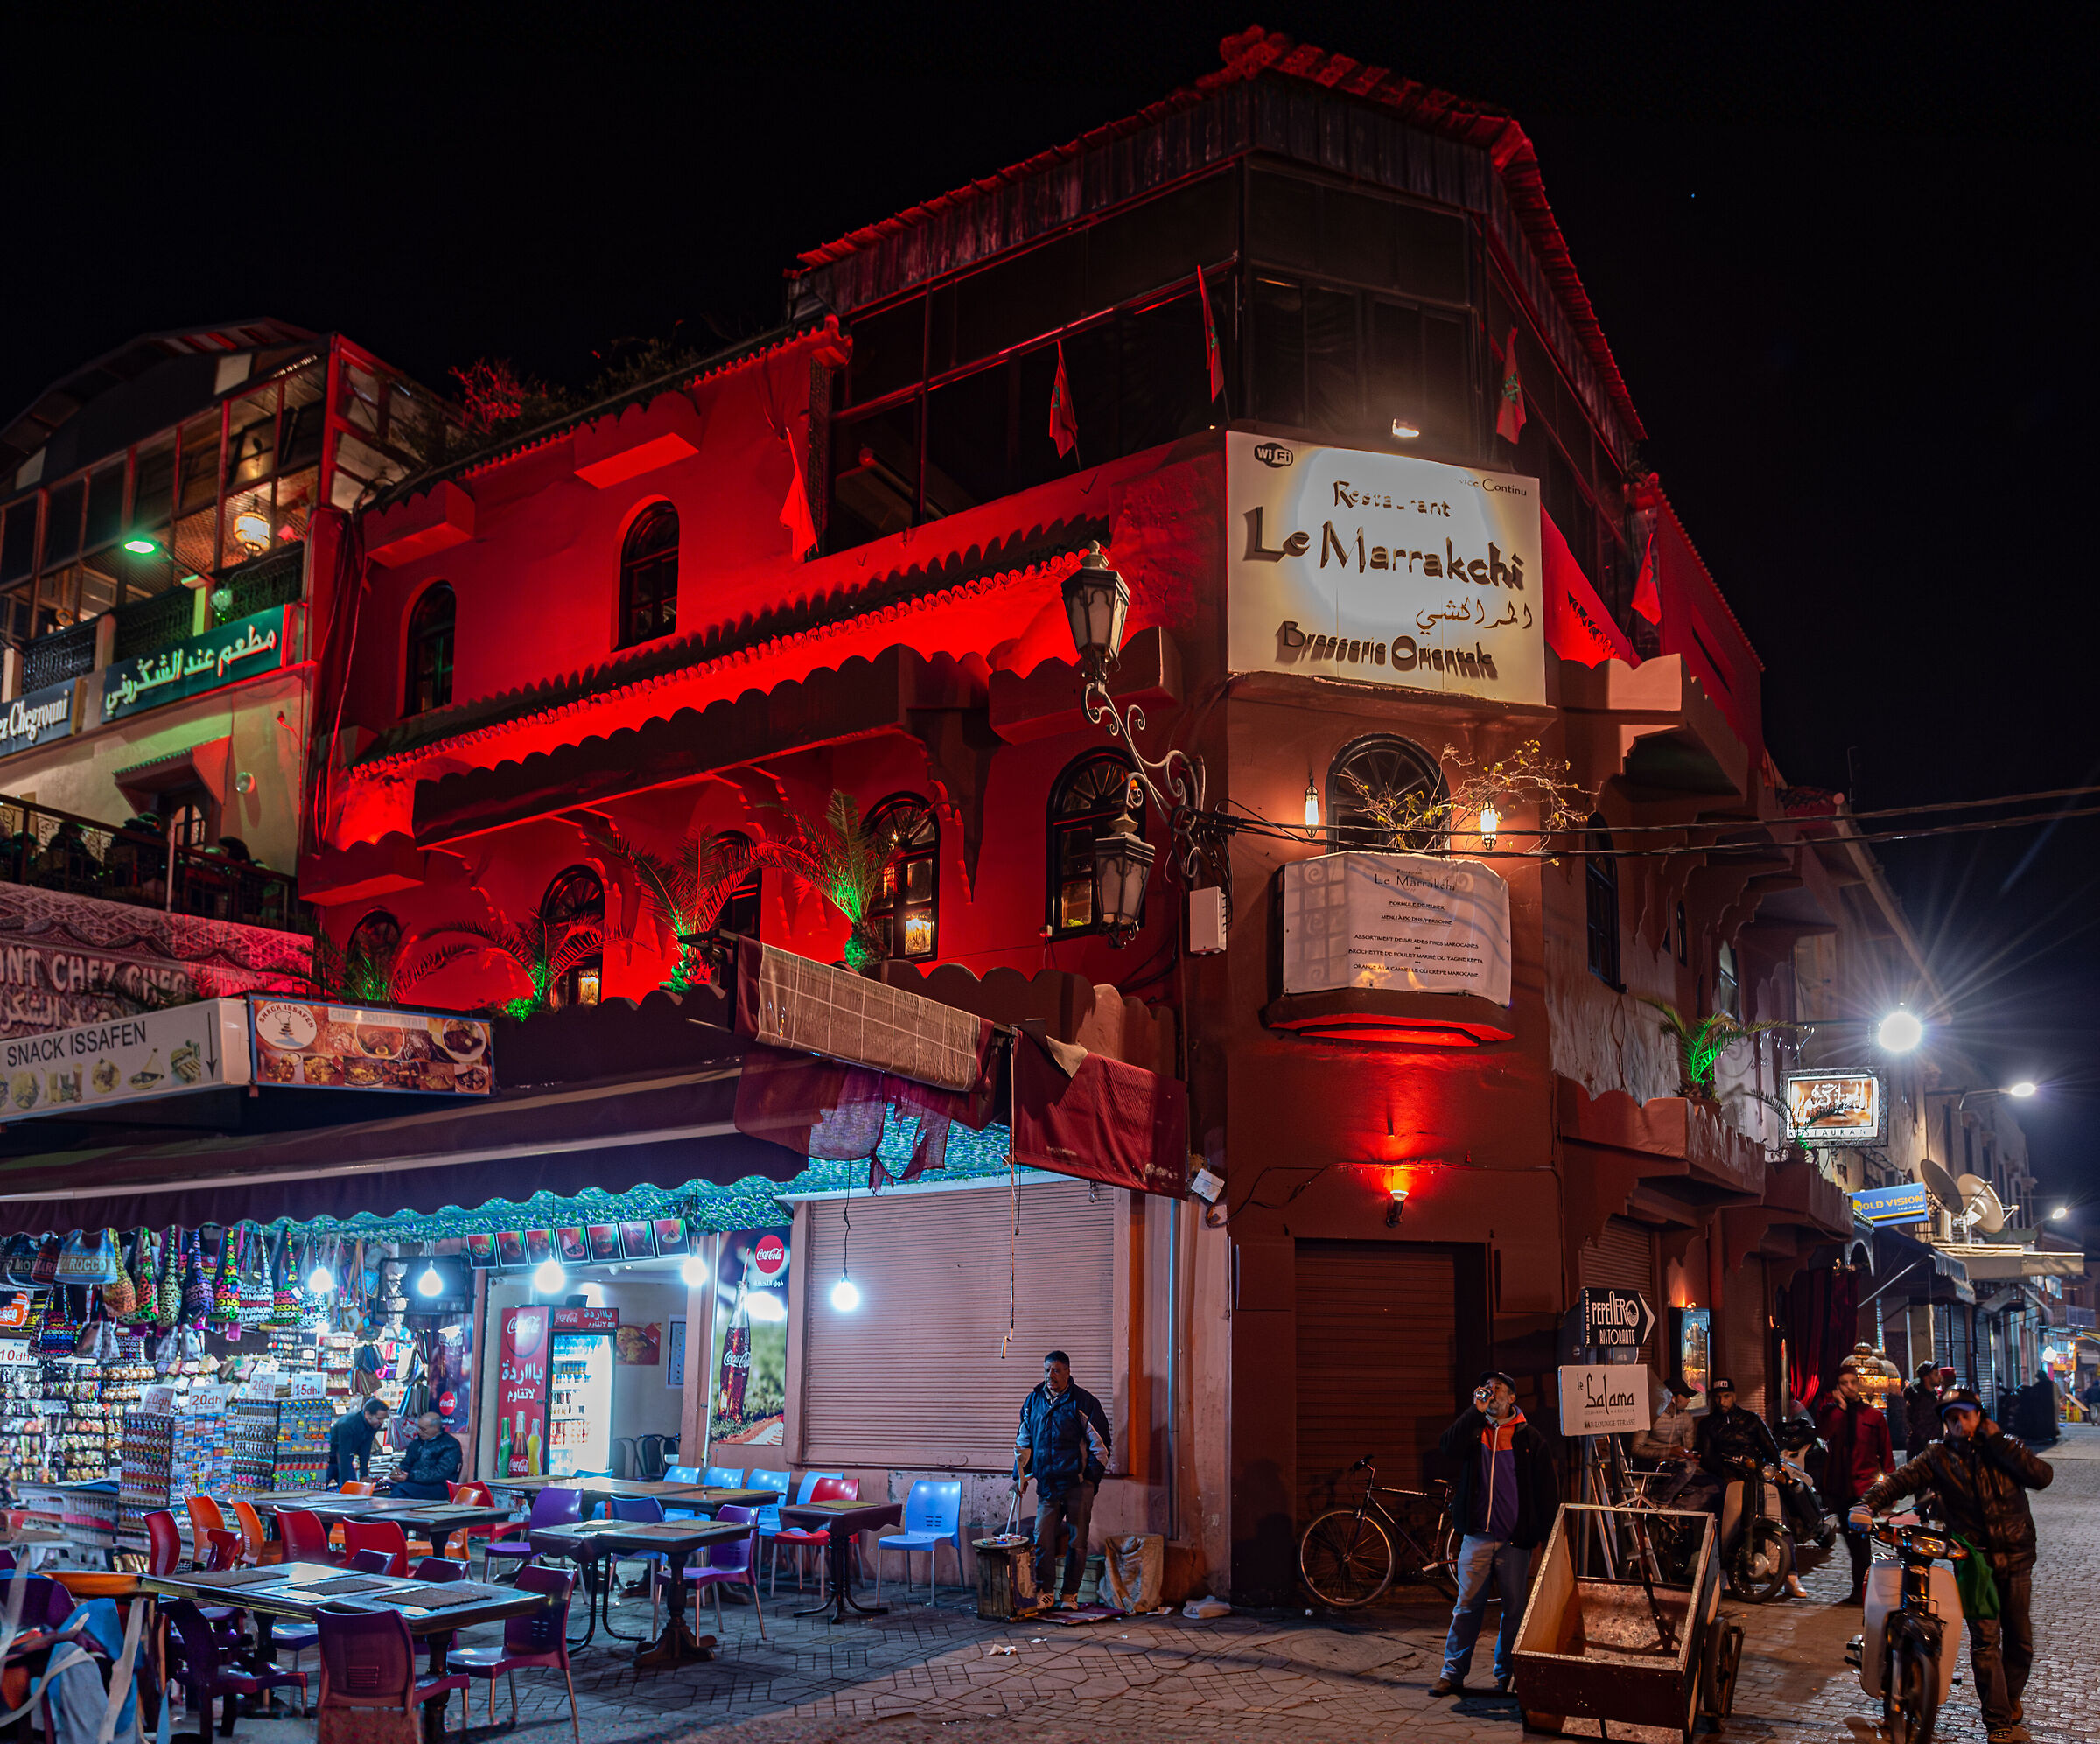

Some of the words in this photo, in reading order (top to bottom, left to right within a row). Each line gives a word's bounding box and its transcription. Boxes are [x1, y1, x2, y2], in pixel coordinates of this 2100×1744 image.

[1482, 478, 1527, 496] Continu
[1246, 507, 1310, 560] Le
[1320, 521, 1524, 590] Marrakchi
[1416, 597, 1533, 634] المراكشي
[217, 625, 276, 678] مطعم
[1278, 620, 1386, 662] Brasserie
[1391, 635, 1494, 676] Orientale
[183, 648, 215, 676] عند
[9, 689, 69, 741] Chegrouni
[1375, 873, 1390, 885] Le
[1396, 875, 1456, 891] Marrakchi
[284, 1005, 315, 1029] ISSAFEN
[7, 1036, 65, 1067] SNACK
[70, 1020, 147, 1055] ISSAFEN
[1886, 1194, 1923, 1207] VISION
[1600, 1328, 1635, 1345] RISTORANTE
[252, 1379, 274, 1391] 20dh
[295, 1383, 318, 1396] 15dh
[1585, 1372, 1634, 1415] Salama
[146, 1391, 170, 1407] 20dh
[192, 1394, 222, 1405] 20dh
